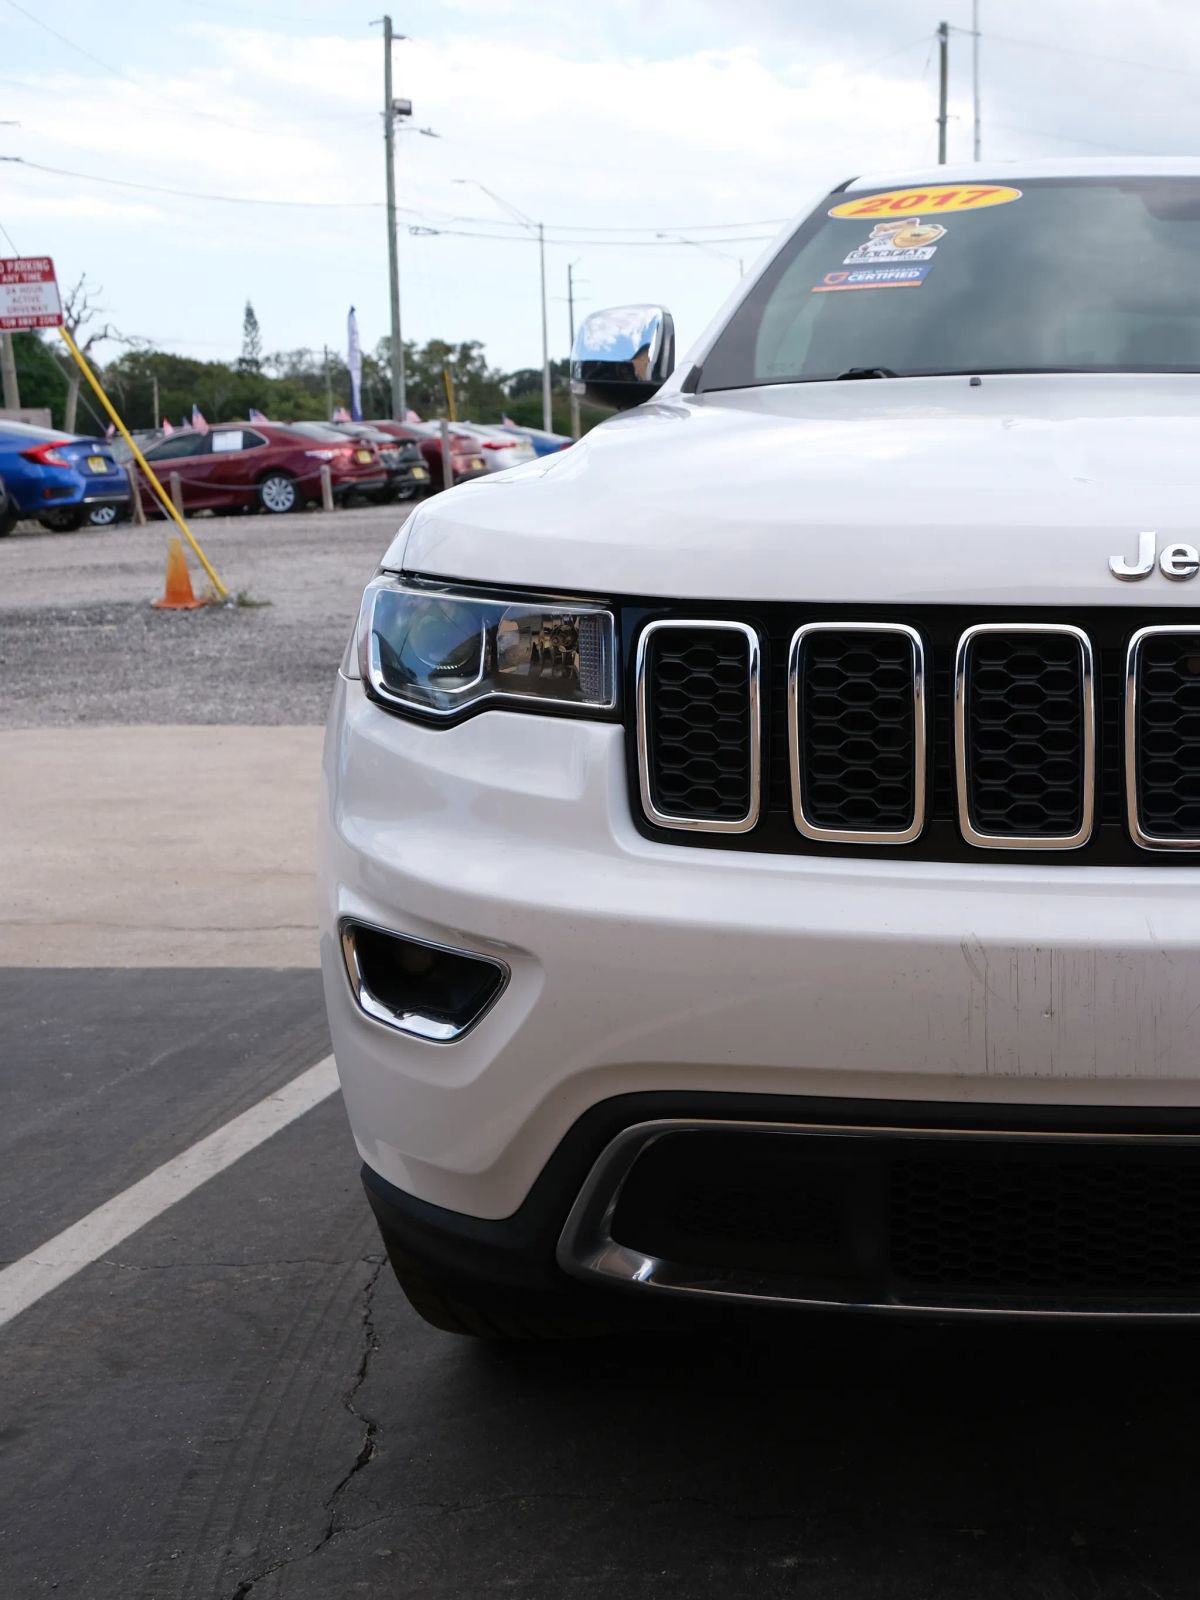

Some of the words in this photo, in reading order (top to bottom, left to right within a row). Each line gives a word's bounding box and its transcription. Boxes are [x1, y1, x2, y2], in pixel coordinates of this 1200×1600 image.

[848, 189, 1002, 215] 2017
[7, 260, 50, 273] PARKING
[2, 274, 20, 283] ANY
[22, 272, 42, 282] TIME
[848, 271, 920, 281] CERTIFIED
[38, 315, 58, 325] ZONE
